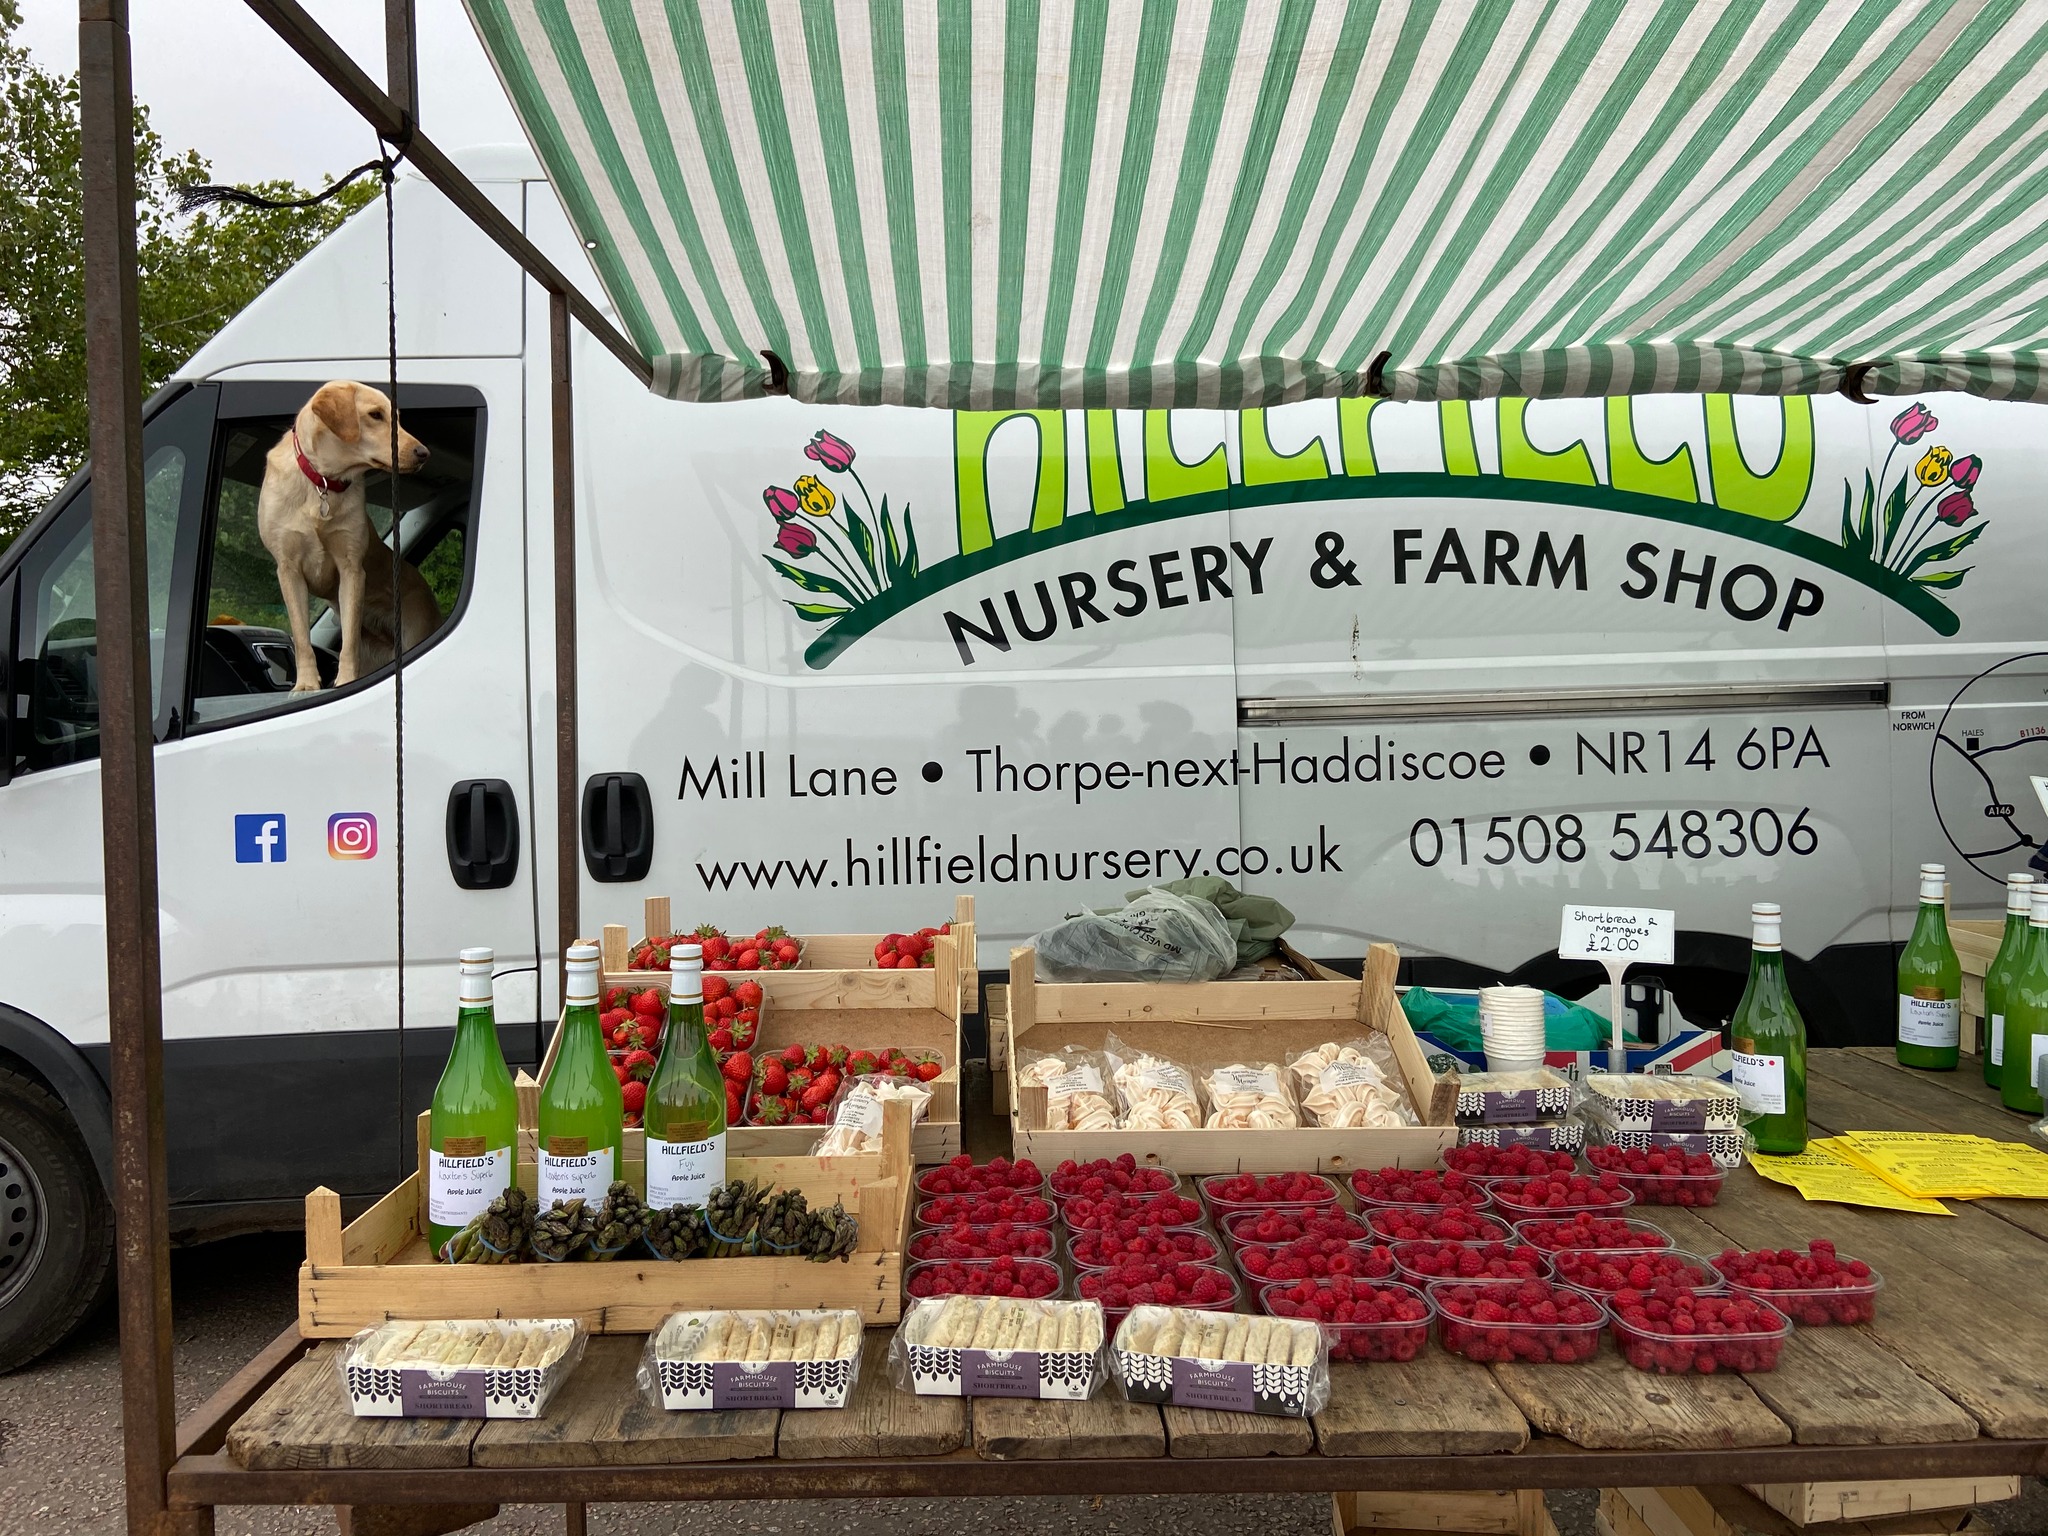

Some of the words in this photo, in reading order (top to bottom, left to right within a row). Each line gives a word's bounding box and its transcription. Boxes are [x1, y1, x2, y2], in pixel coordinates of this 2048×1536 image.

[943, 537, 1274, 666] NURSERY
[1310, 531, 1362, 589] &
[1393, 528, 1588, 591] FARM
[1620, 542, 1825, 632] SHOP
[1901, 711, 1926, 720] FROM
[1892, 721, 1936, 732] NORWICH
[1961, 729, 1985, 737] HALES
[2019, 726, 2047, 739] B1136
[678, 751, 765, 801] Mill
[789, 754, 897, 798] Lane
[966, 735, 1506, 805] Thorpe-next-Haddiscoe
[1577, 727, 1716, 775] NR14
[1736, 725, 1831, 771] 6PA
[1988, 806, 2011, 816] A146
[1409, 813, 1586, 867] 01508
[1609, 807, 1819, 860] 548306
[695, 825, 1343, 893] www.hillfieldnursery.co.uk
[1574, 911, 1637, 925] Shortbread
[1911, 1000, 1952, 1010] HILLFIELD'S
[661, 1141, 715, 1155] HILLFIELD'S
[438, 1156, 494, 1169] HILLFIELD'S
[545, 1156, 597, 1168] HILLFIELD'S
[671, 1174, 689, 1182] Apple
[690, 1172, 706, 1181] Juice
[447, 1188, 464, 1196] Apple
[466, 1187, 483, 1196] Juice
[552, 1187, 568, 1195] Apple
[569, 1187, 586, 1195] Juice
[977, 1361, 1023, 1373] FARMHOUSE
[729, 1373, 778, 1383] FARMHOUSE
[1189, 1371, 1236, 1383] FARMHOUSE
[418, 1380, 467, 1391] FARMHOUSE
[972, 1382, 1028, 1391] SHORTBREAD
[1197, 1379, 1229, 1388] BISCUITS
[427, 1388, 460, 1396] BISCUITS
[1185, 1392, 1242, 1403] SHORTBREAD
[414, 1402, 473, 1410] SHORTBREAD
